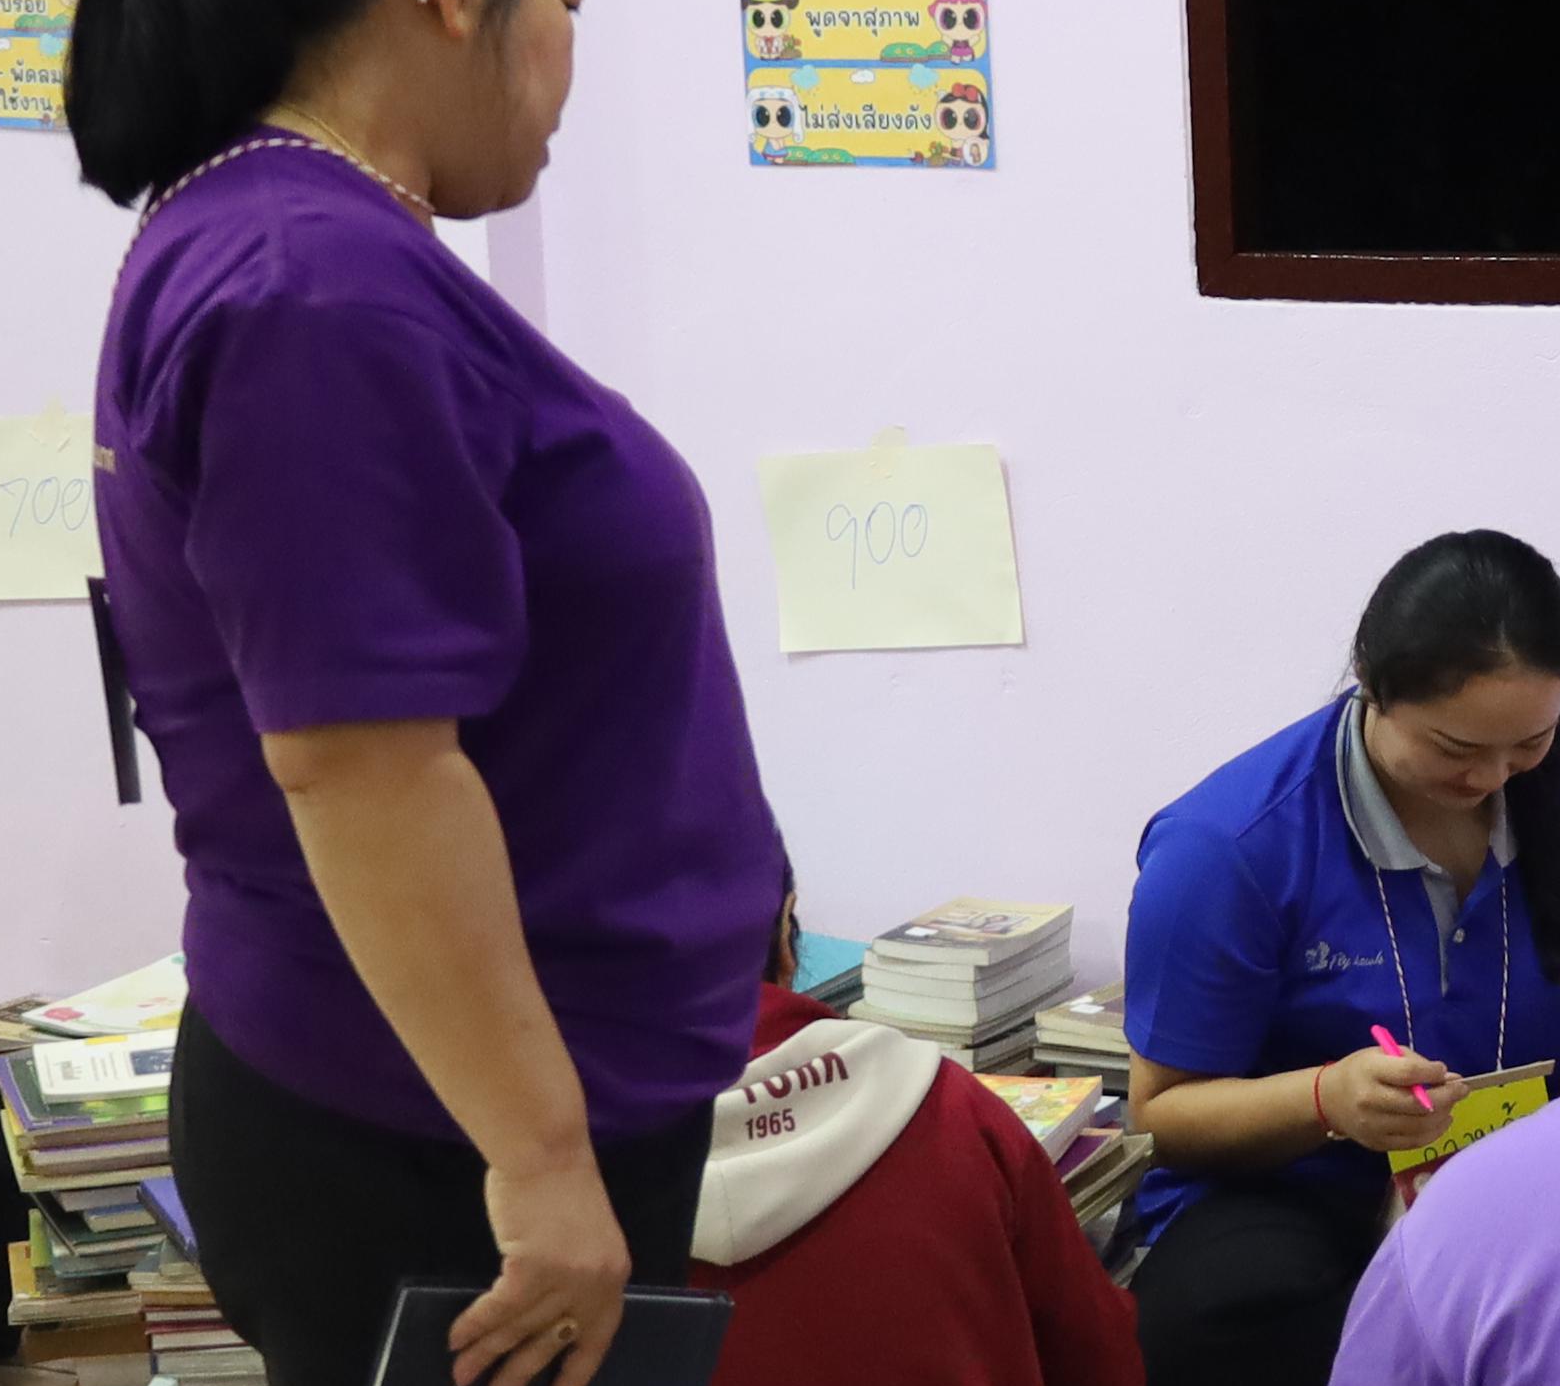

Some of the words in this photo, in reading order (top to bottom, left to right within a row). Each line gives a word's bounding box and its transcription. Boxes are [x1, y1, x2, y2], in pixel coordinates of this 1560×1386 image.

[805, 7, 920, 38] พูดจาสุภาพ
[799, 103, 932, 130] ไม่ส่งเสียงดัง
[0, 476, 91, 538] 700
[826, 500, 928, 589] 900
[745, 1109, 796, 1140] 1965
